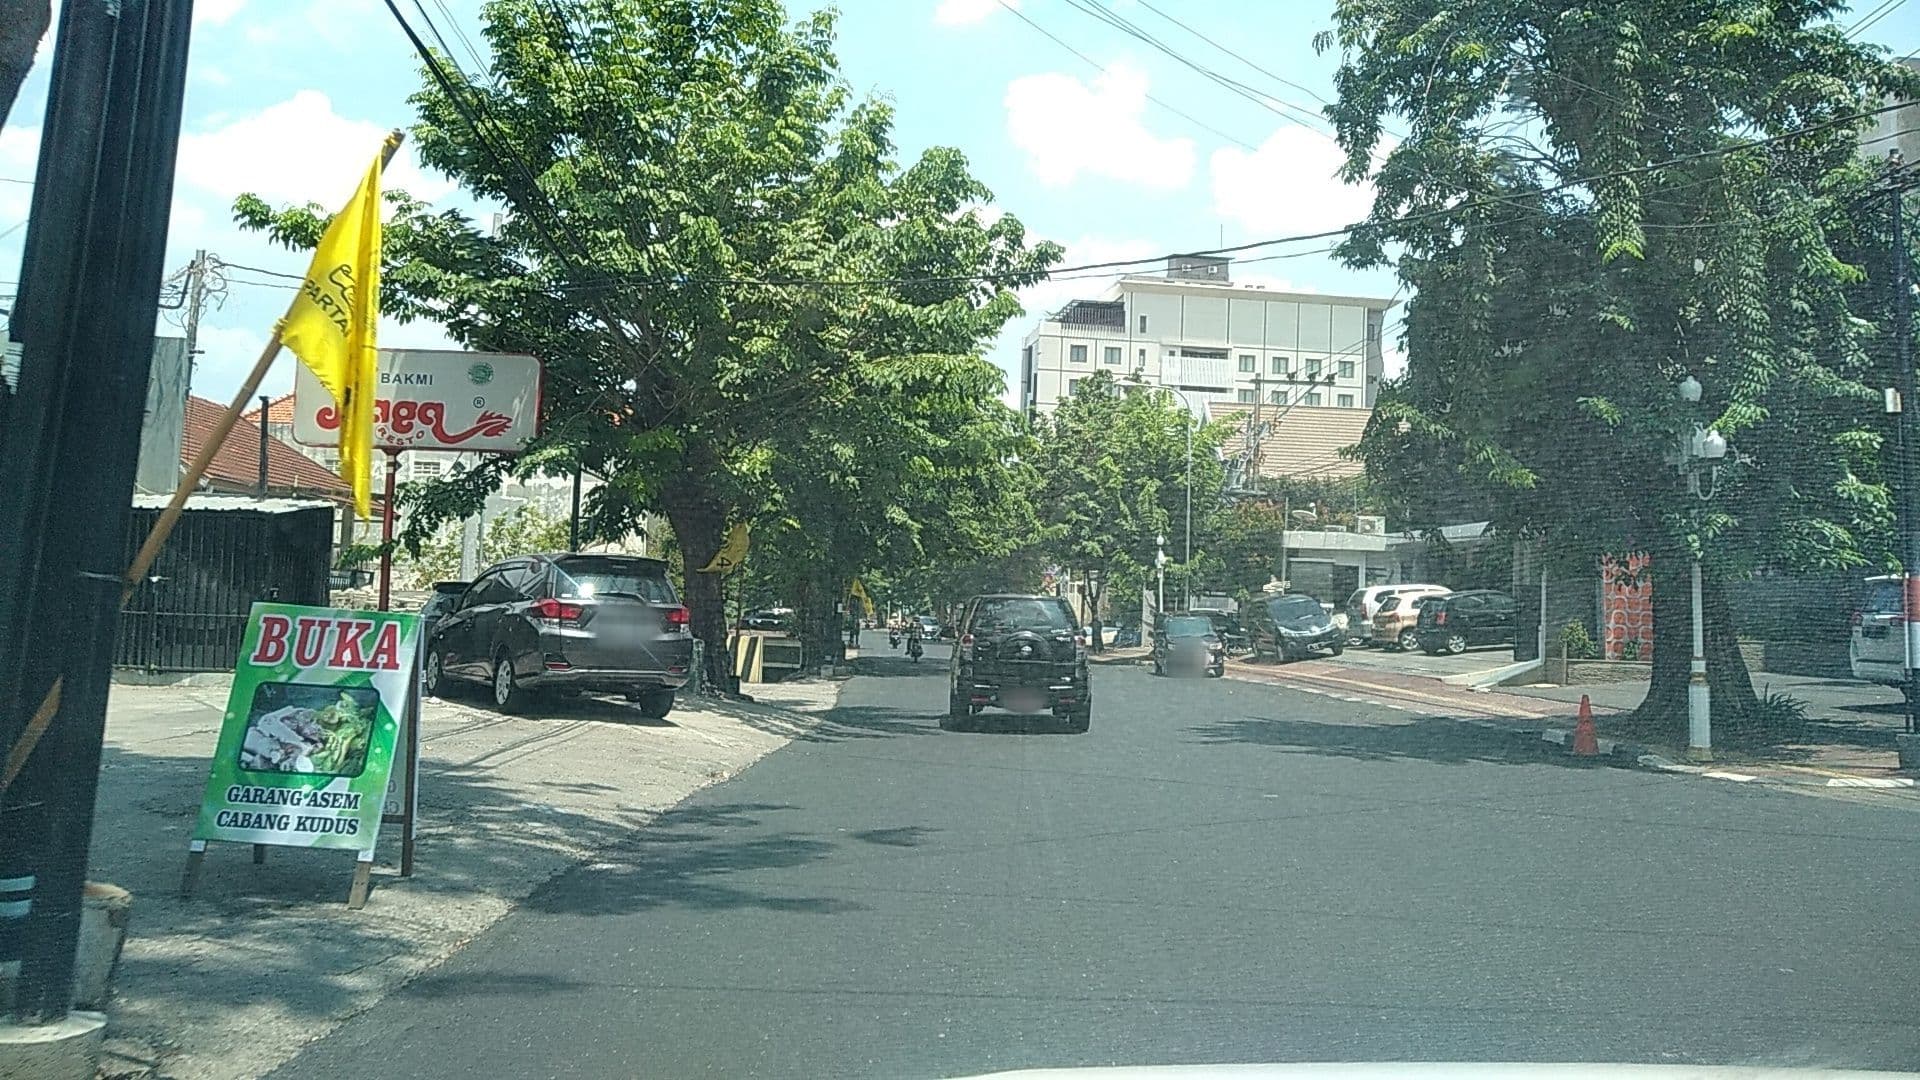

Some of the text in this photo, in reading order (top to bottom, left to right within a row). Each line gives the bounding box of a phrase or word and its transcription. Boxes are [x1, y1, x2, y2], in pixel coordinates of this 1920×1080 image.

[380, 372, 433, 386] BAKMI
[378, 427, 425, 446] RESTO
[251, 616, 400, 670] BUKA
[227, 786, 302, 807] GARANG
[306, 792, 361, 810] ASEM
[216, 811, 360, 835] CABANG KUDUS
